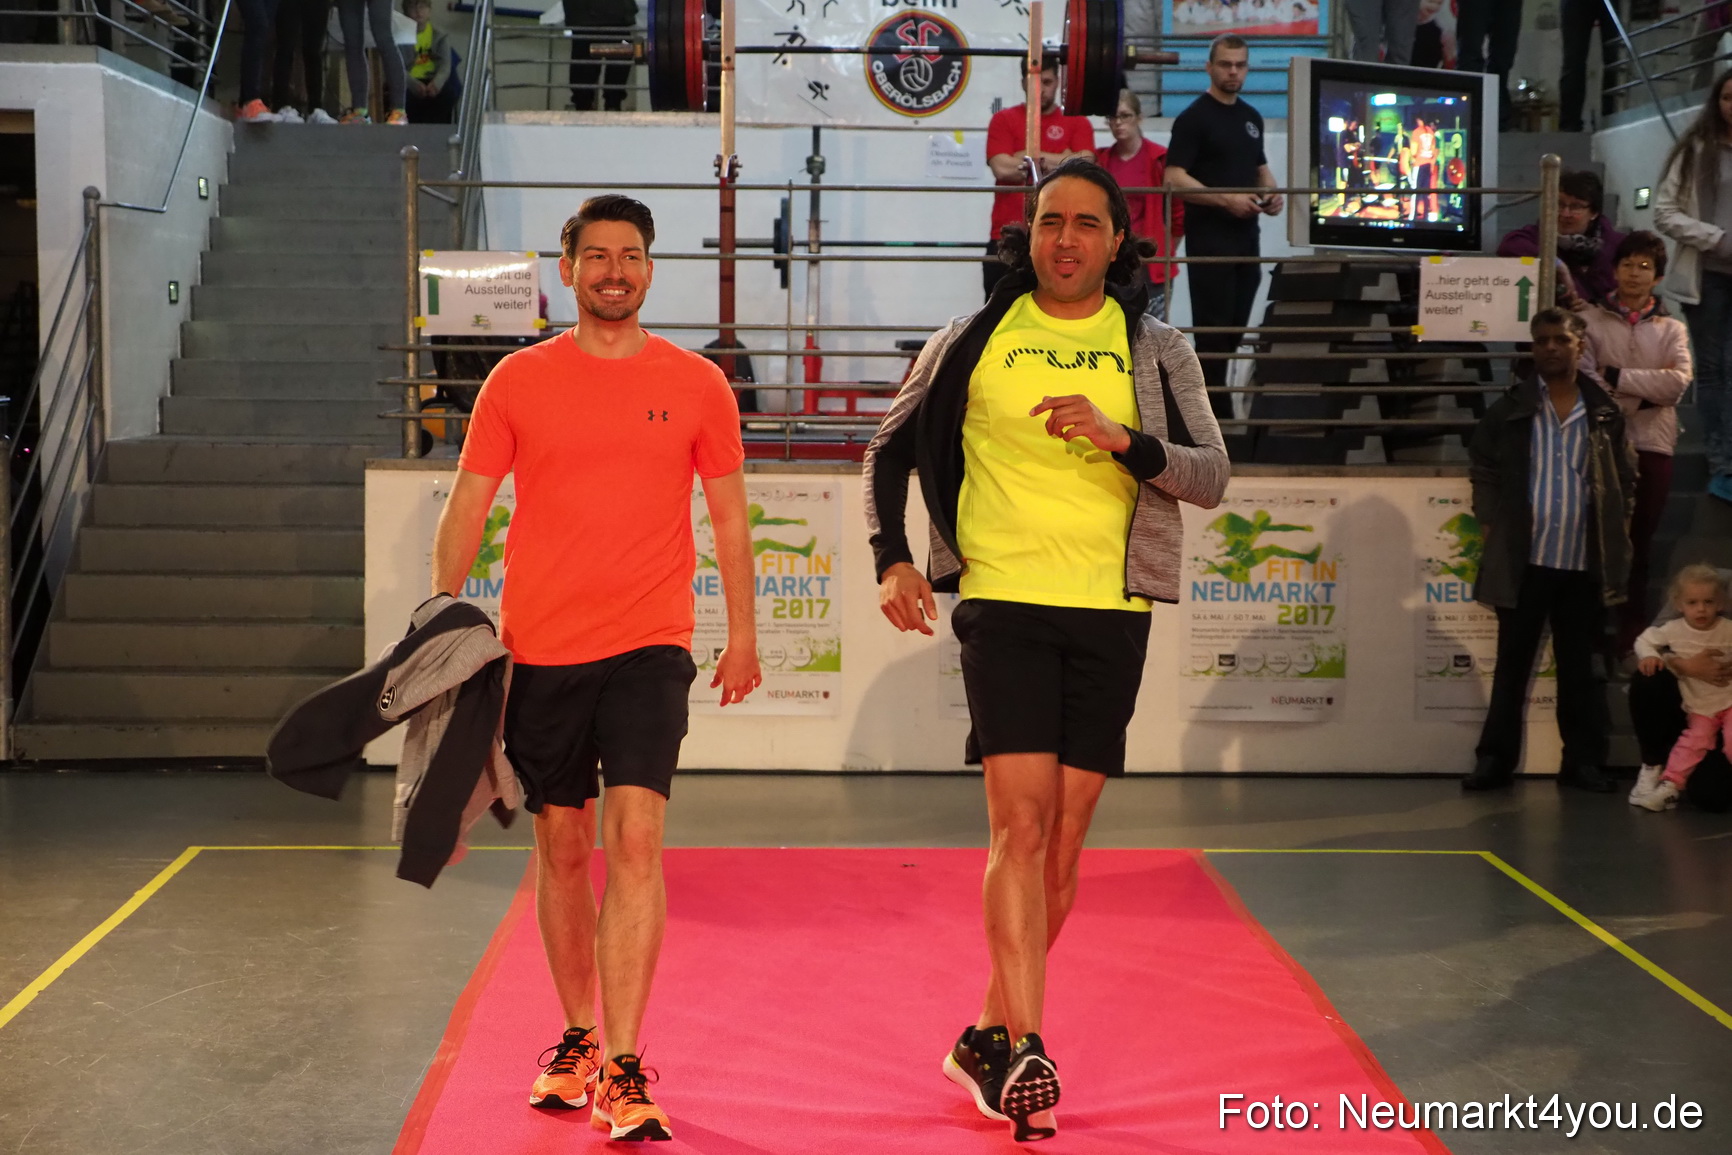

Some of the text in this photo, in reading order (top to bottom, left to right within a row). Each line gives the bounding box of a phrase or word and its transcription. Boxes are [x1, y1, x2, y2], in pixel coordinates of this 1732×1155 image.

[872, 60, 963, 108] OBERÖLSBACH
[464, 284, 532, 297] Ausstellung
[1463, 275, 1490, 289] geht
[1493, 275, 1510, 286] die
[493, 299, 532, 310] weiter!
[1425, 289, 1492, 303] Ausstellung
[1424, 304, 1463, 315] weiter!
[761, 553, 832, 575] FIT IN
[1266, 559, 1338, 582] FIT IN
[691, 575, 831, 597] NEARKT
[1191, 580, 1337, 603] NEUMARKT
[772, 597, 831, 619] 2017
[1276, 604, 1336, 626] 2017
[767, 690, 820, 700] NEUMARKT
[1271, 696, 1325, 705] NEUMARKT
